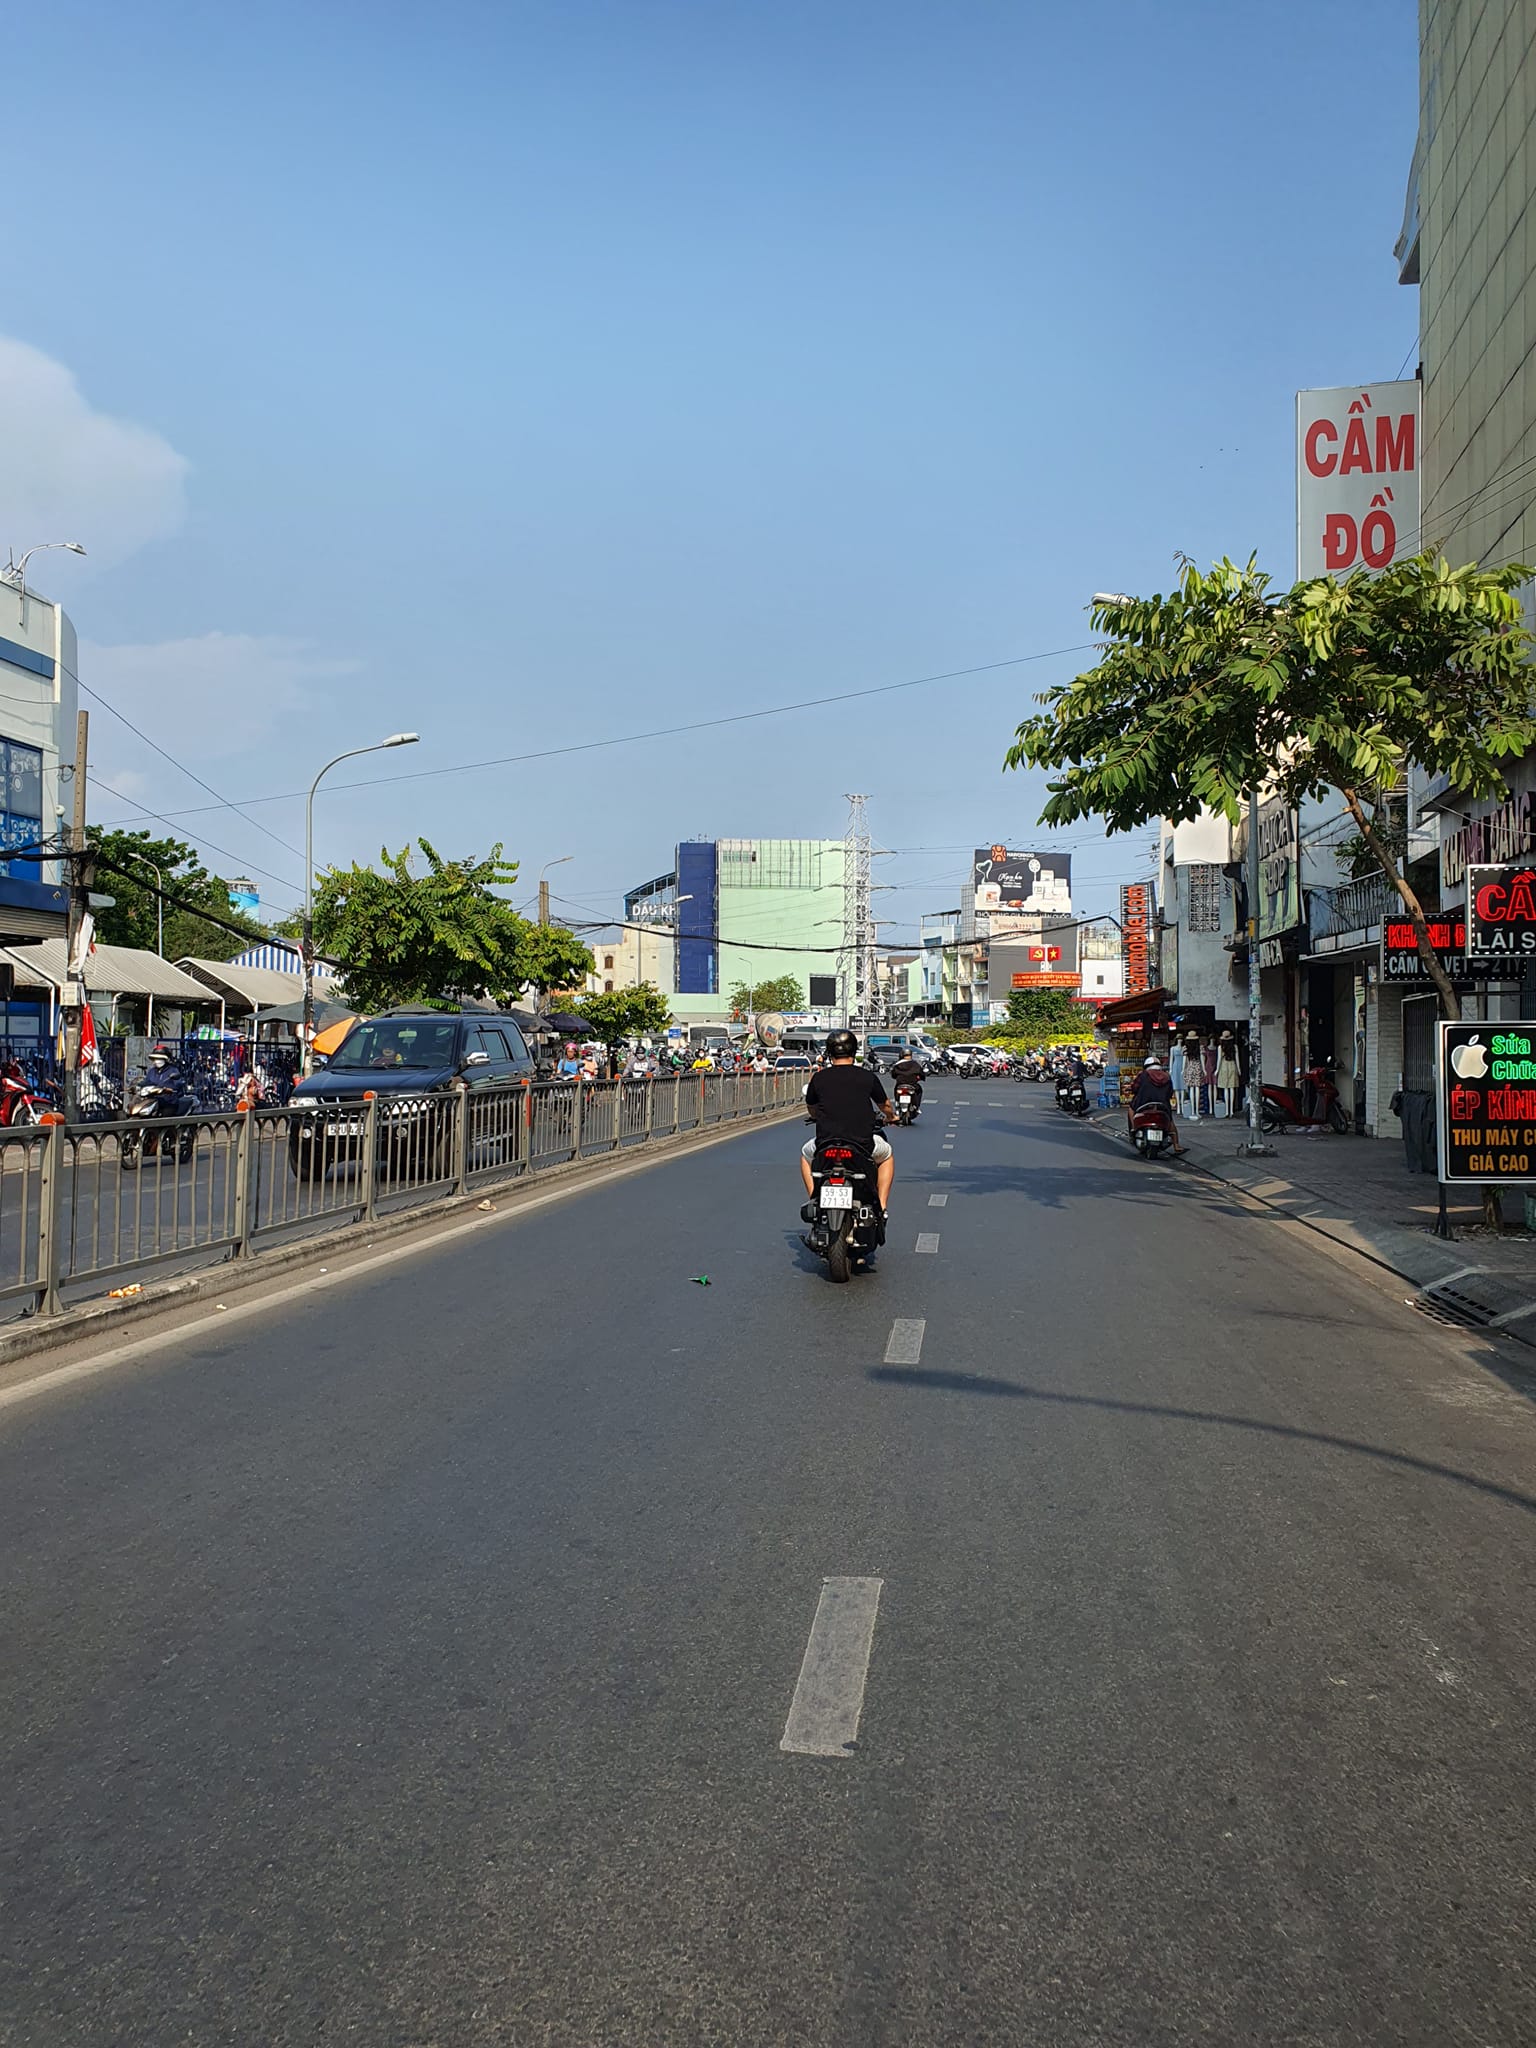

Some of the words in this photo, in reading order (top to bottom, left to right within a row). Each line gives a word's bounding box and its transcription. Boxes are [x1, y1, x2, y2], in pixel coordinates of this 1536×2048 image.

[1305, 393, 1415, 478] CẦM
[1322, 487, 1397, 569] ĐỒ
[1388, 924, 1450, 948] KHNH
[1477, 927, 1514, 949] LÃI
[1389, 950, 1418, 974] CẦM
[1491, 1033, 1531, 1055] Sửa
[1451, 1084, 1481, 1120] ÉP
[1452, 1128, 1481, 1146] THU
[1485, 1125, 1519, 1146] MÁY
[1469, 1151, 1495, 1172] GIÁ
[1499, 1154, 1529, 1172] CAO
